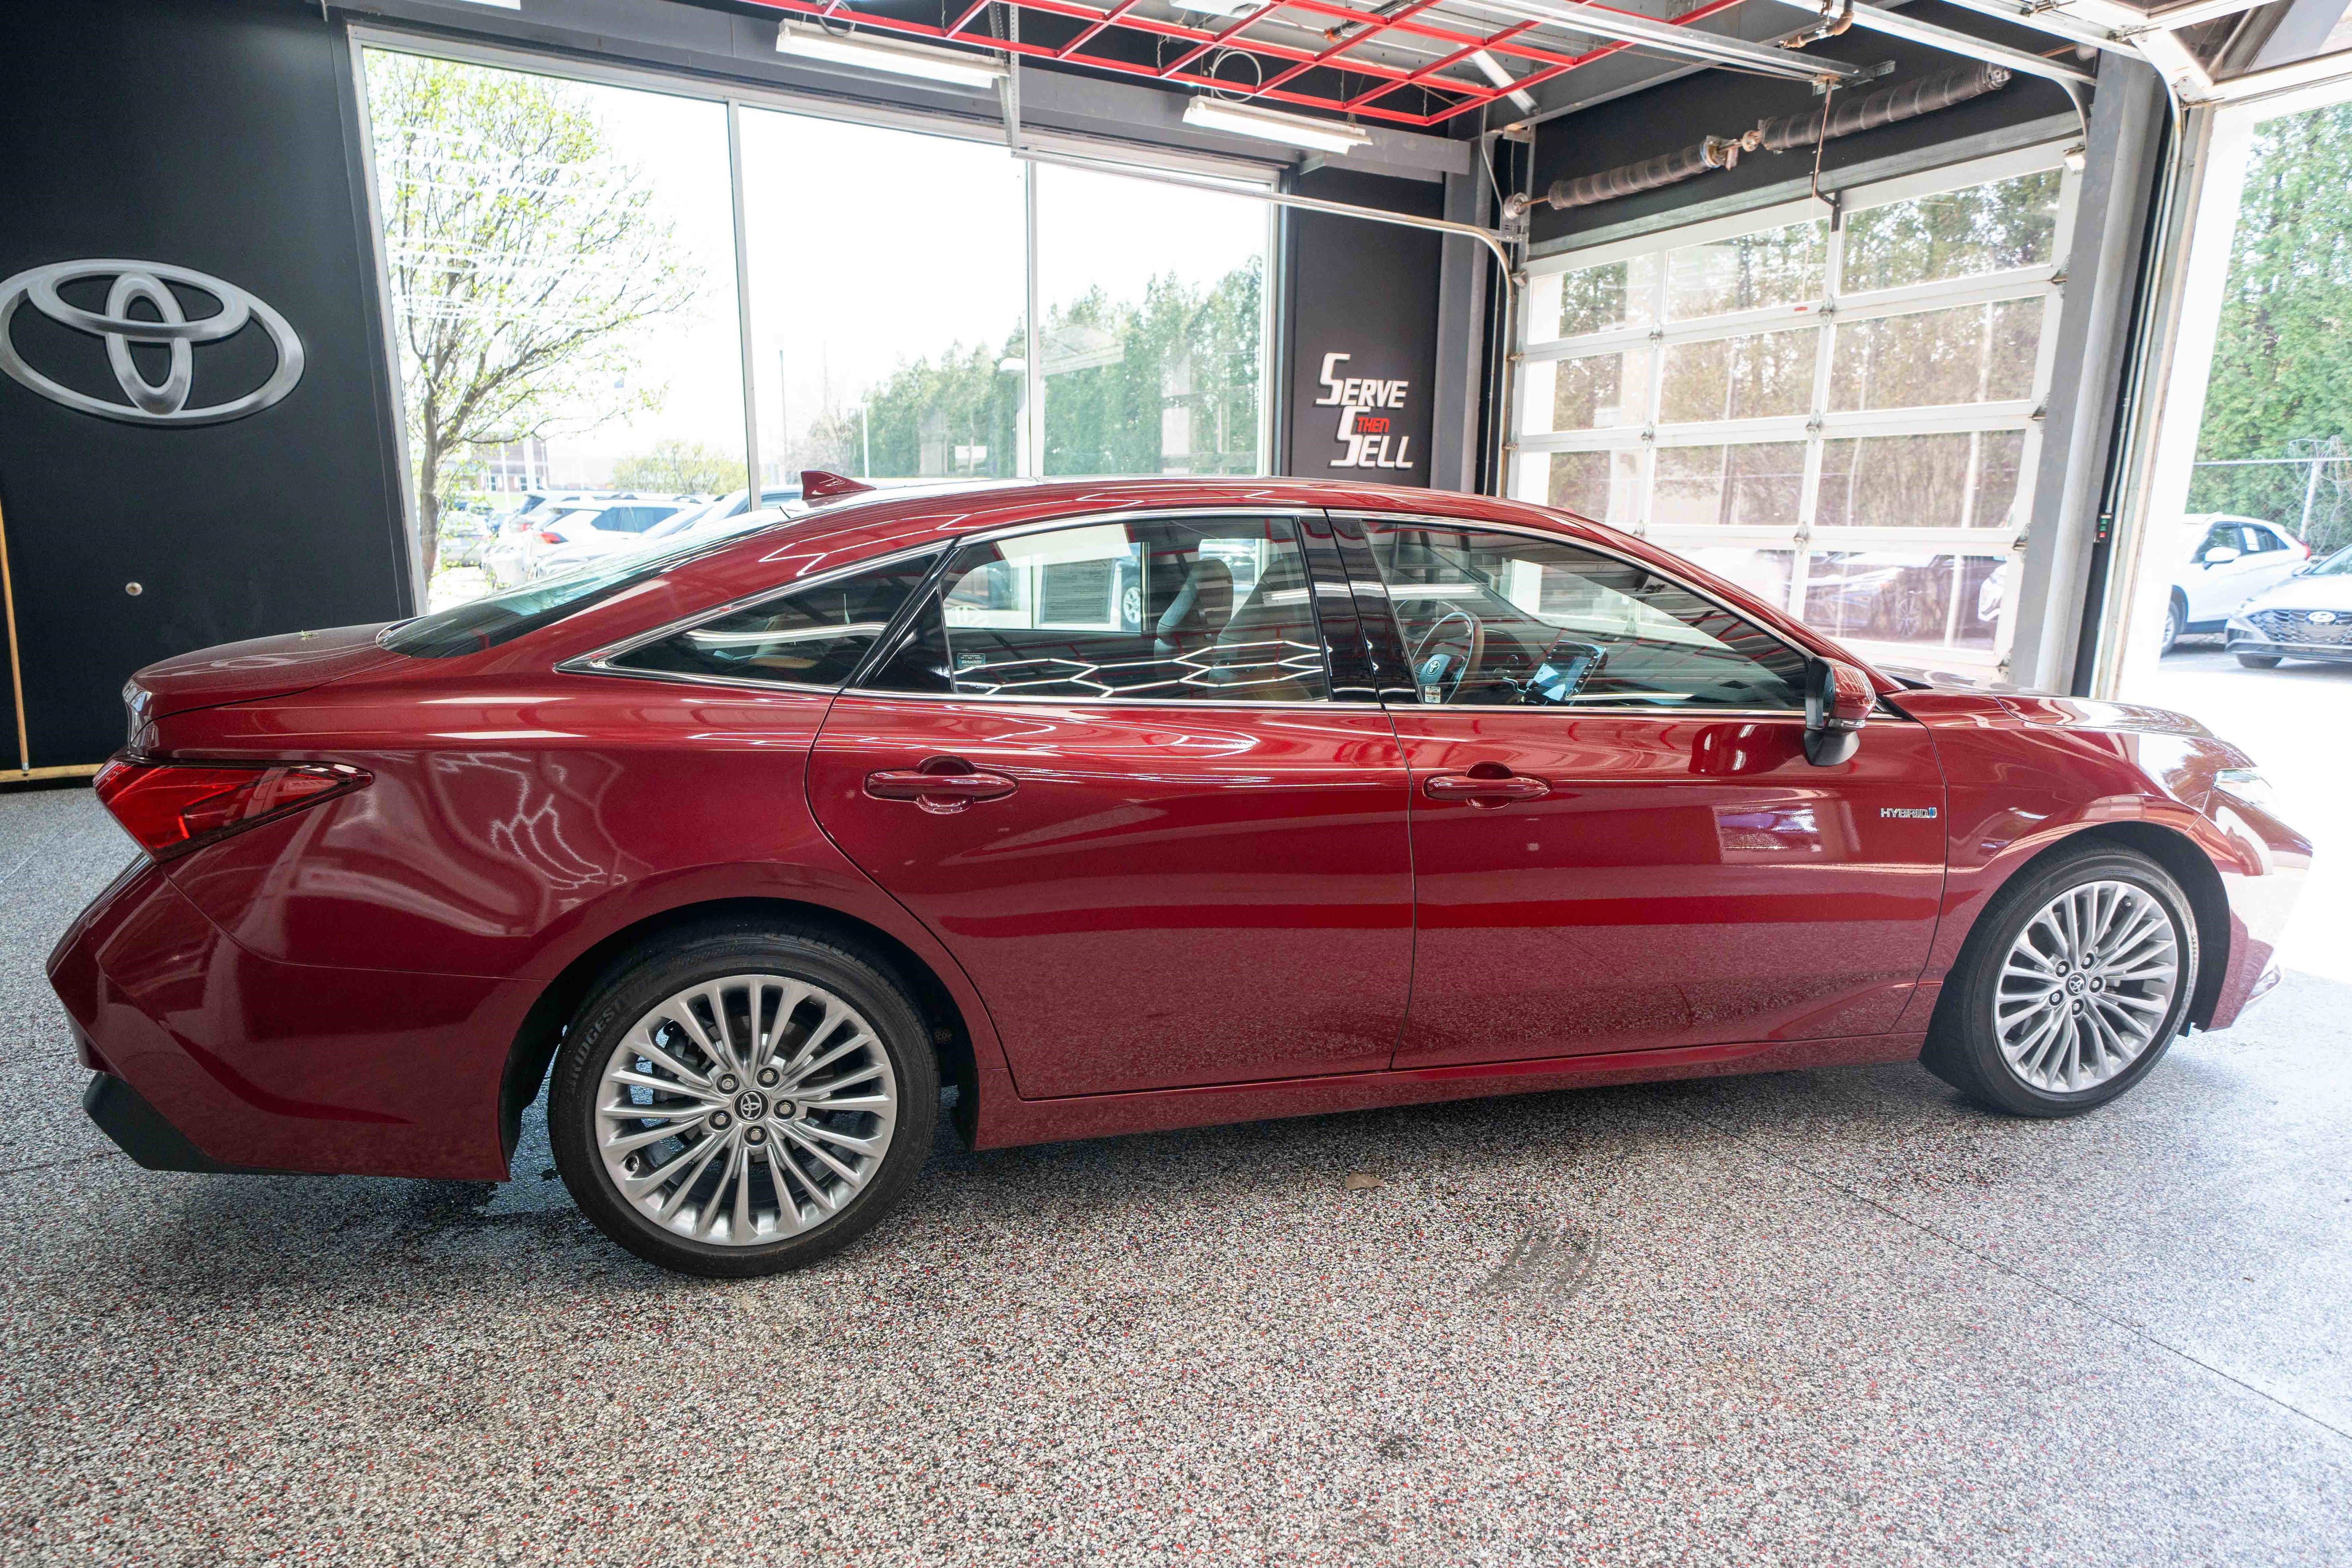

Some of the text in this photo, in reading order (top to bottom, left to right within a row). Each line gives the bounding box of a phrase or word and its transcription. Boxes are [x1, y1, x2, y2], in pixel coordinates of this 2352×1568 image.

[1315, 352, 1409, 408] SERVE
[1330, 405, 1414, 469] SELL
[1356, 416, 1390, 434] THEN
[1880, 808, 1928, 818] HYBRID
